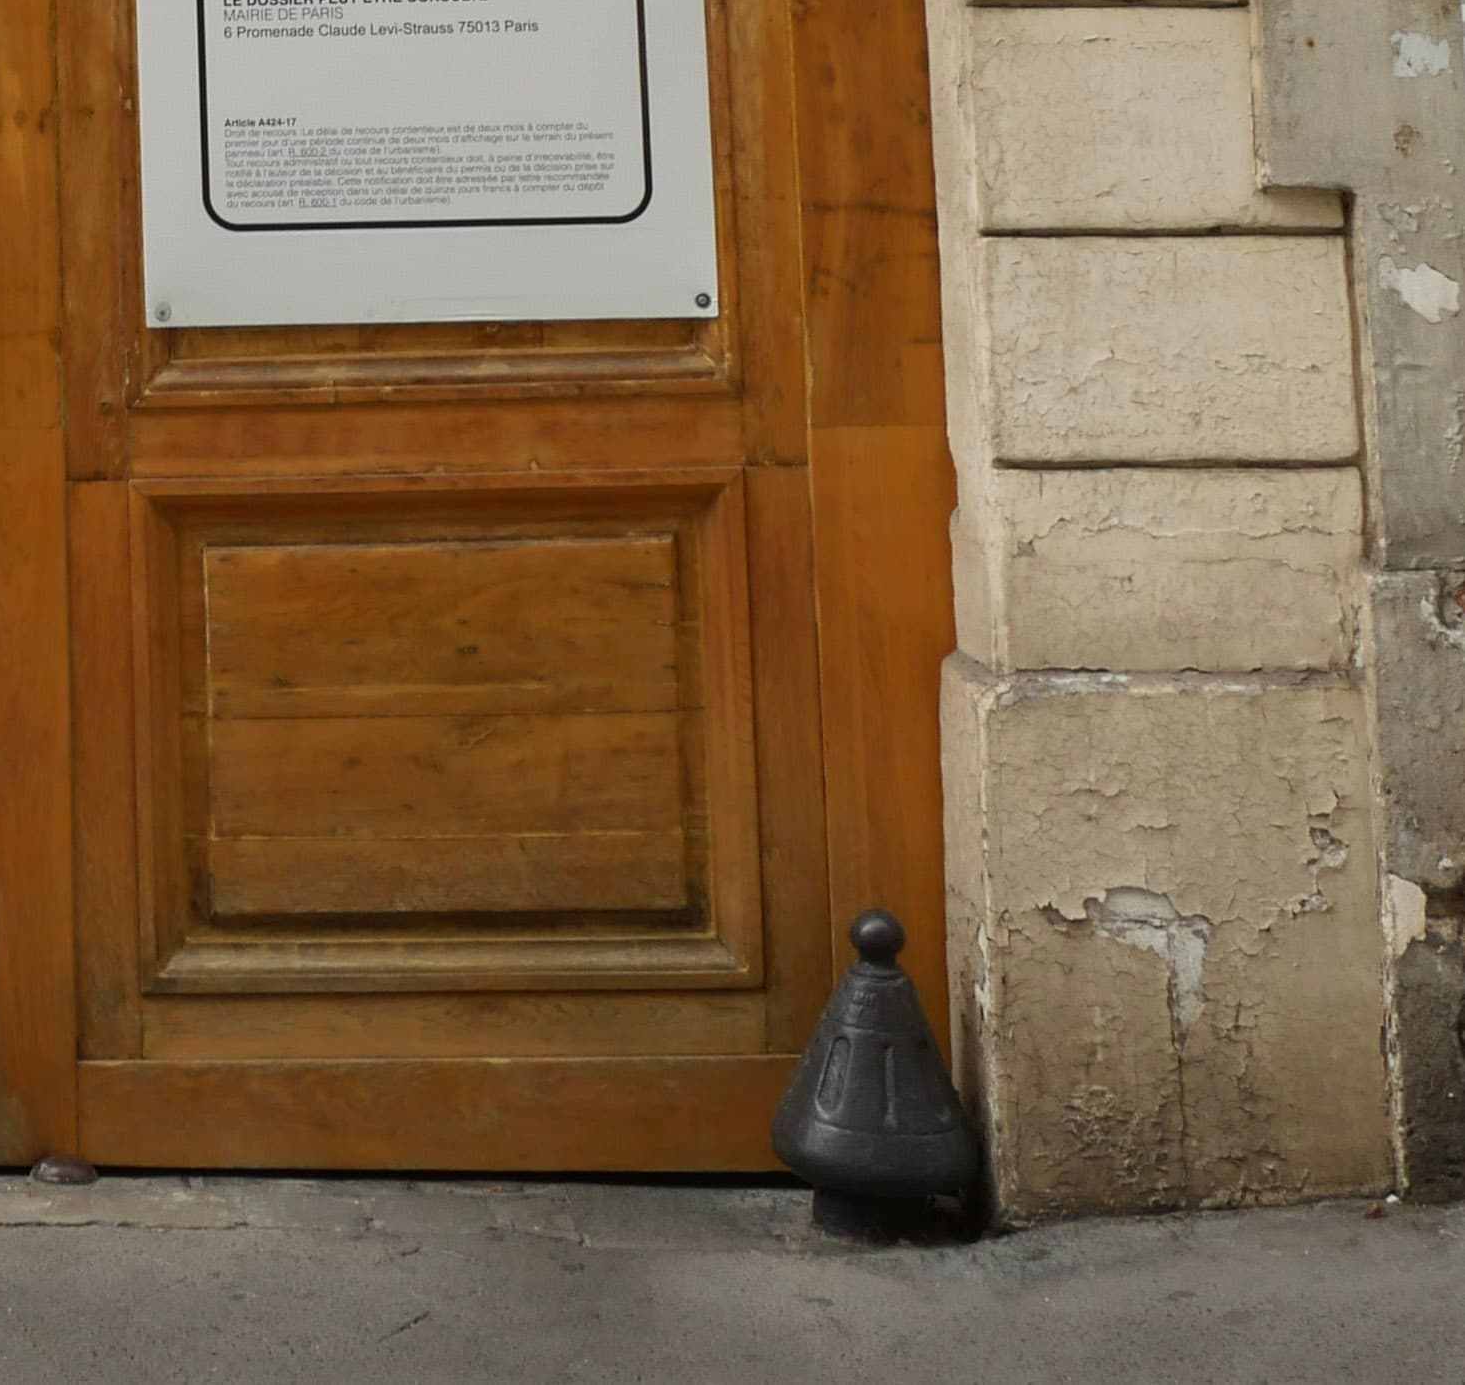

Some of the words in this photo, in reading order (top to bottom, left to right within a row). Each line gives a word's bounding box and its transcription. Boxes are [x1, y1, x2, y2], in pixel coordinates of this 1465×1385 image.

[222, 7, 273, 22] MAIRIE
[277, 6, 297, 20] DE
[301, 5, 343, 20] PARIS
[223, 25, 232, 38] 6
[236, 24, 314, 38] Promenade
[317, 23, 366, 37] Claude
[457, 19, 500, 33] 75013
[504, 19, 539, 32] Paris
[224, 118, 255, 126] Article
[258, 117, 296, 126] A424-17
